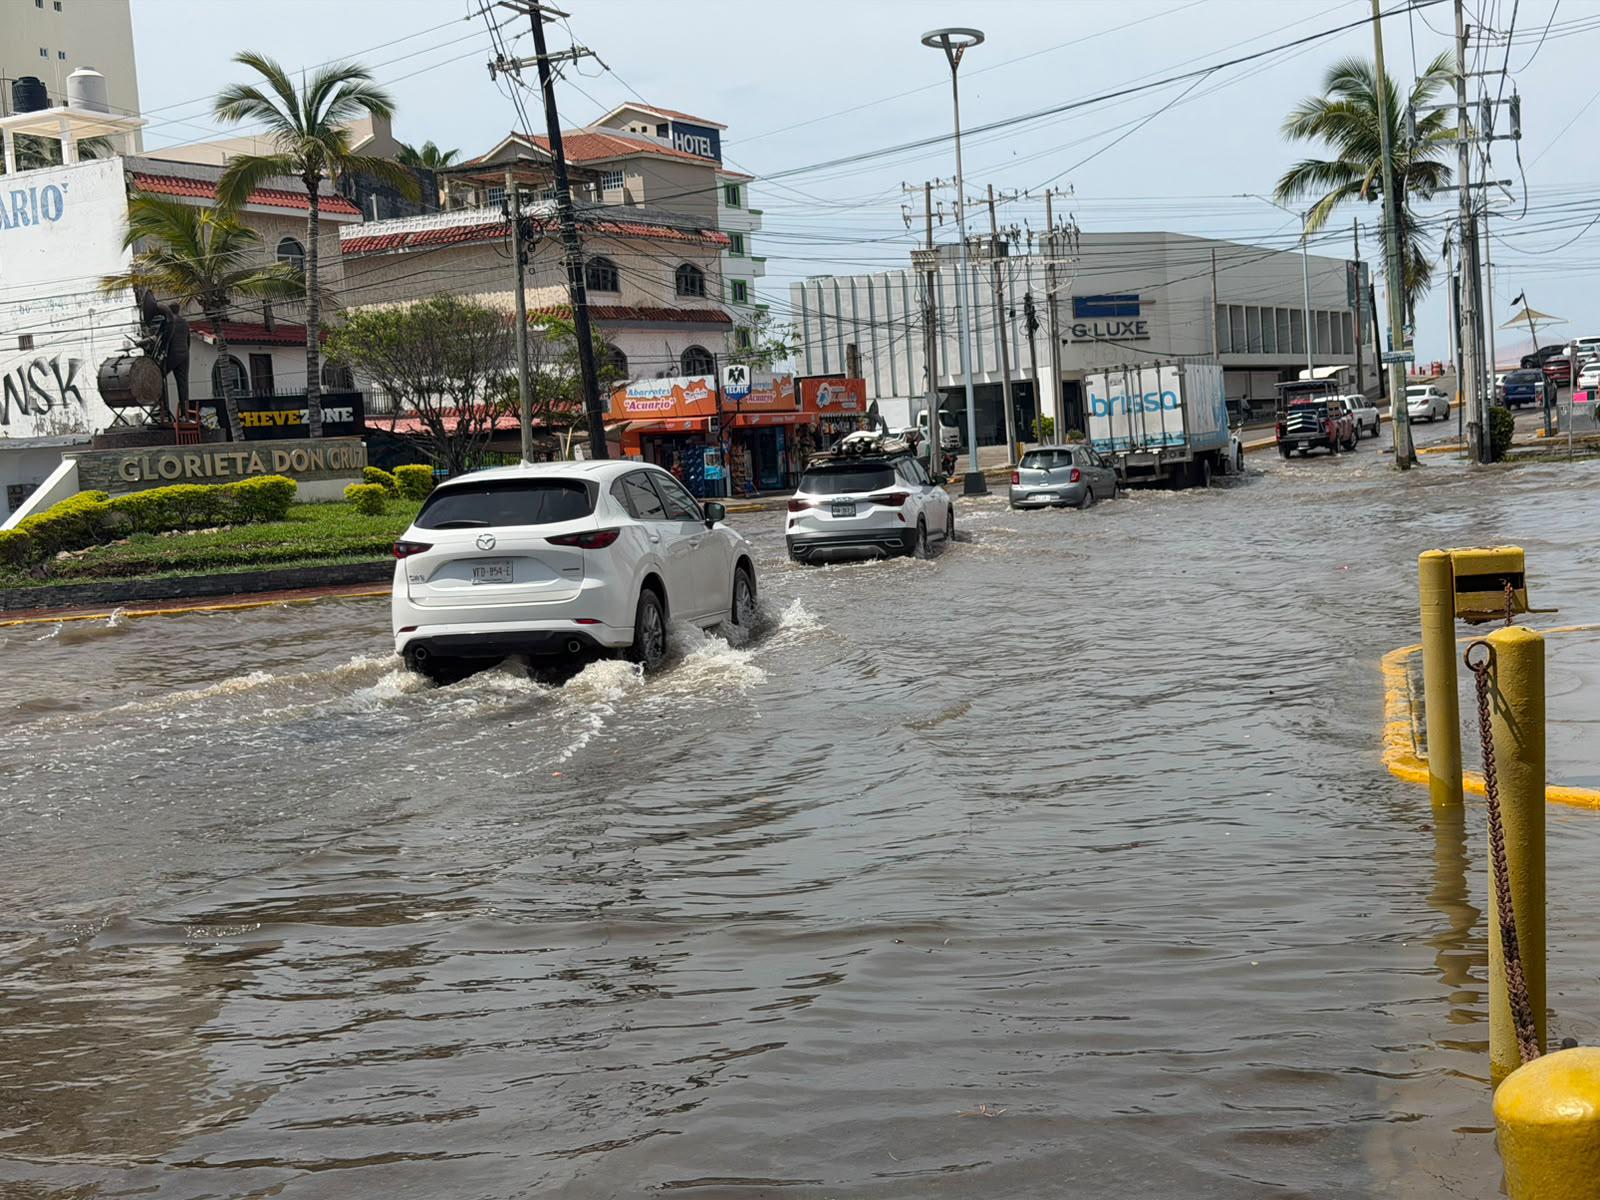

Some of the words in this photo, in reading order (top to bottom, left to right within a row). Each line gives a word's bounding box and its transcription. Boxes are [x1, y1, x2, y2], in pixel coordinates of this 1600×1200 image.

[674, 132, 715, 157] HOTEL
[628, 388, 671, 397] Abarrotes
[725, 385, 749, 394] TECATE
[238, 407, 354, 427] CHEVEZNE
[118, 451, 266, 482] GLORIETA
[272, 448, 323, 472] DON
